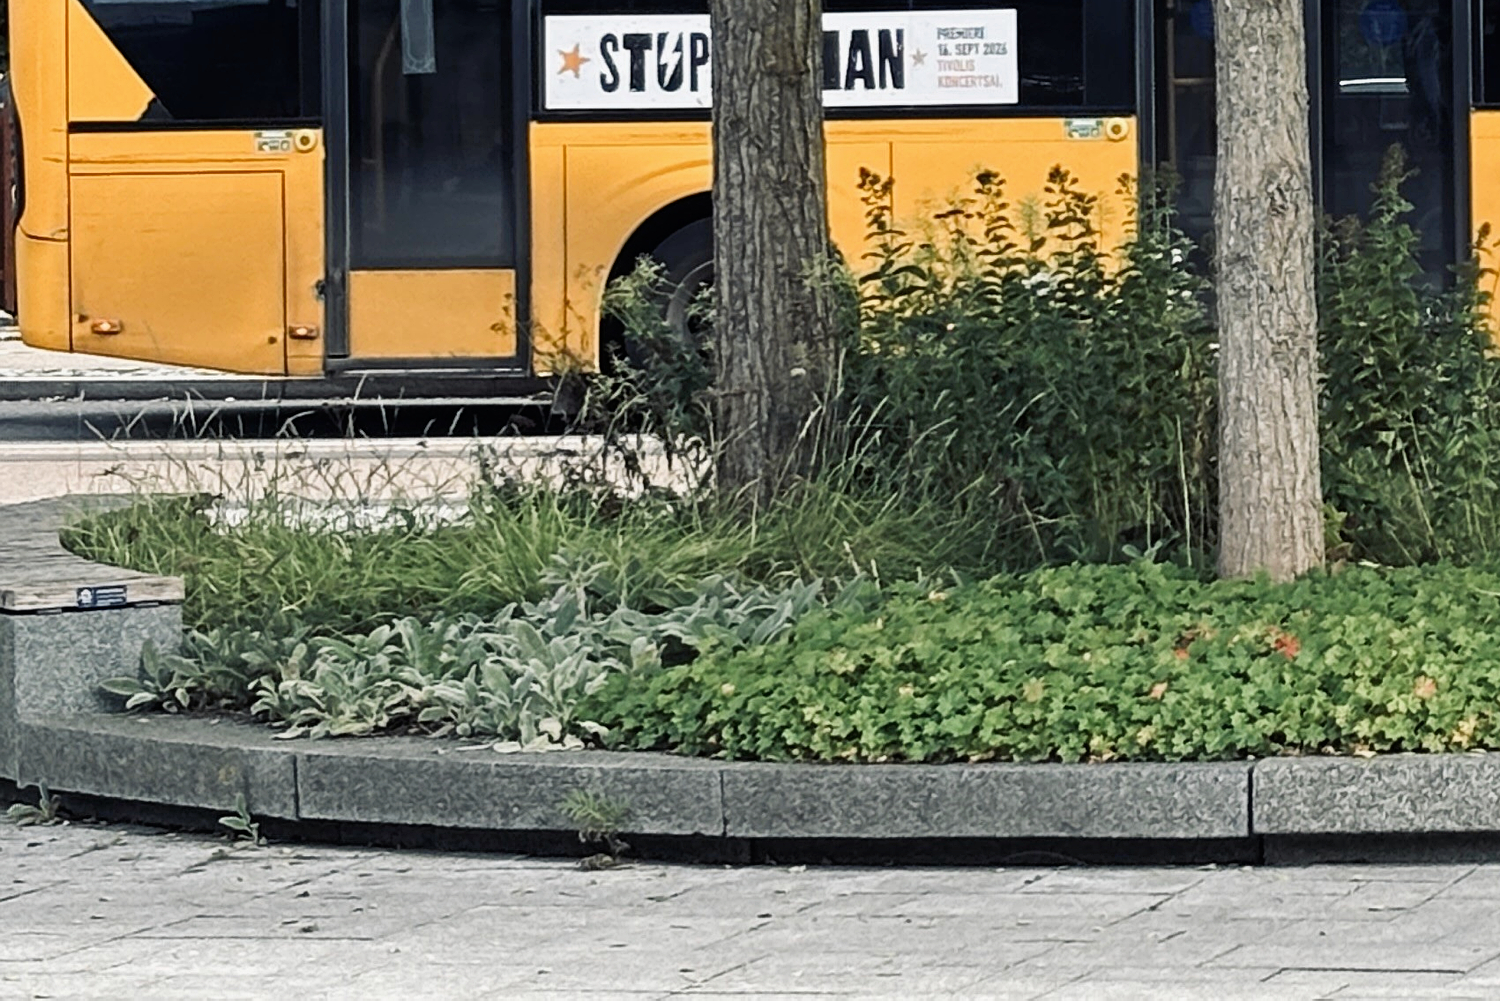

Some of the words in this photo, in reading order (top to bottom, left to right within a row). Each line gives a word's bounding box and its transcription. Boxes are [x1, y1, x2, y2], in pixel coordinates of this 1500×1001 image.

[955, 43, 980, 56] SEPT
[599, 32, 709, 92] STUP
[937, 59, 975, 72] TIVOLIS
